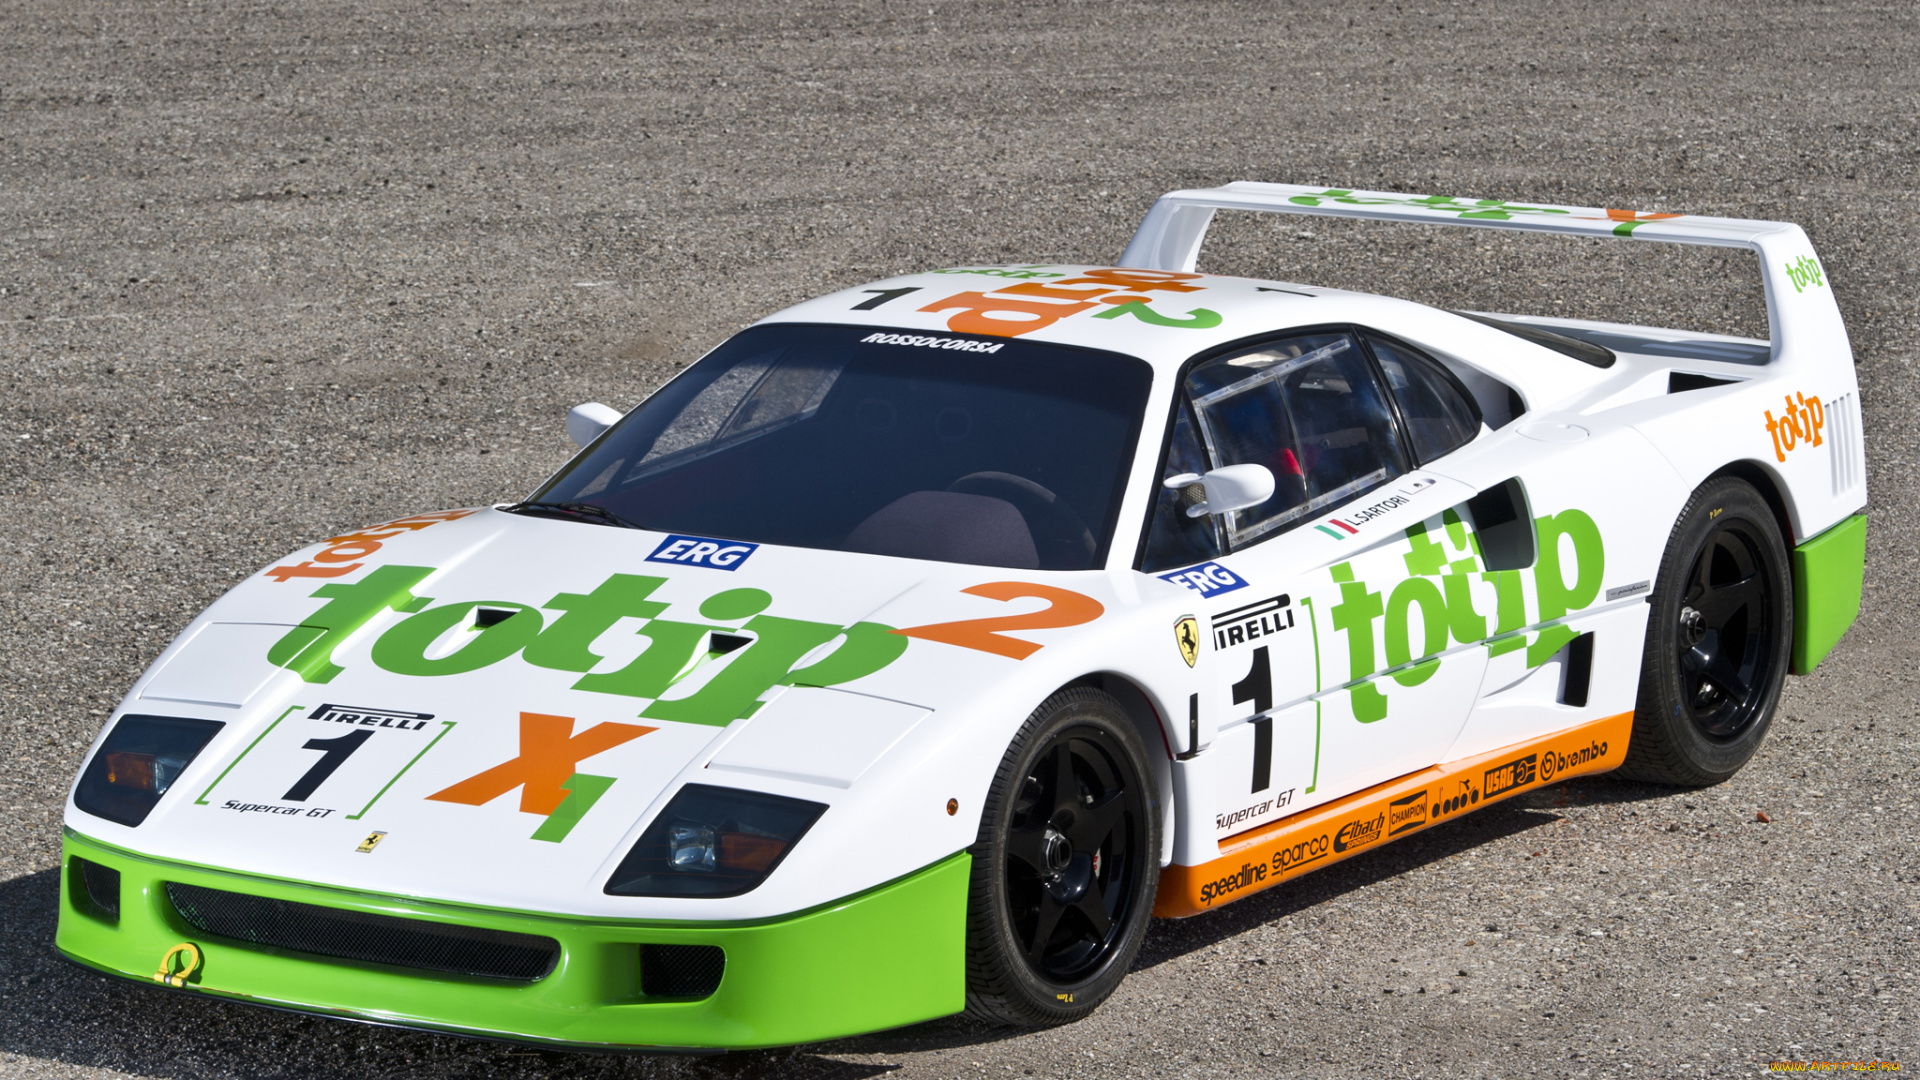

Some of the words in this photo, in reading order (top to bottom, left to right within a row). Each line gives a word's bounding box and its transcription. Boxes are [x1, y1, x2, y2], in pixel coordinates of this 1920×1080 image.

[1785, 255, 1823, 293] totip
[850, 286, 924, 311] 1
[860, 332, 1005, 354] ROSSOCORSA
[1764, 391, 1824, 463] totip
[1344, 494, 1410, 526] L.SARTORI
[652, 538, 751, 568] ERG
[1168, 564, 1238, 593] ERG
[884, 581, 1105, 661] 2
[1211, 593, 1295, 651] PIRELLI
[1329, 508, 1604, 724] totip
[267, 565, 907, 727] totip
[307, 703, 435, 731] PIRELLI
[1231, 646, 1273, 794] 1
[281, 729, 376, 802] 1
[1557, 741, 1608, 772] brembo
[1486, 765, 1515, 795] USAG
[221, 799, 304, 817] Supercar
[305, 807, 336, 819] GT
[1277, 788, 1297, 808] GT
[1390, 800, 1426, 825] CHAMPION
[1333, 811, 1385, 853] Eibach
[1272, 834, 1329, 876] sparco
[1200, 862, 1267, 906] speedline
